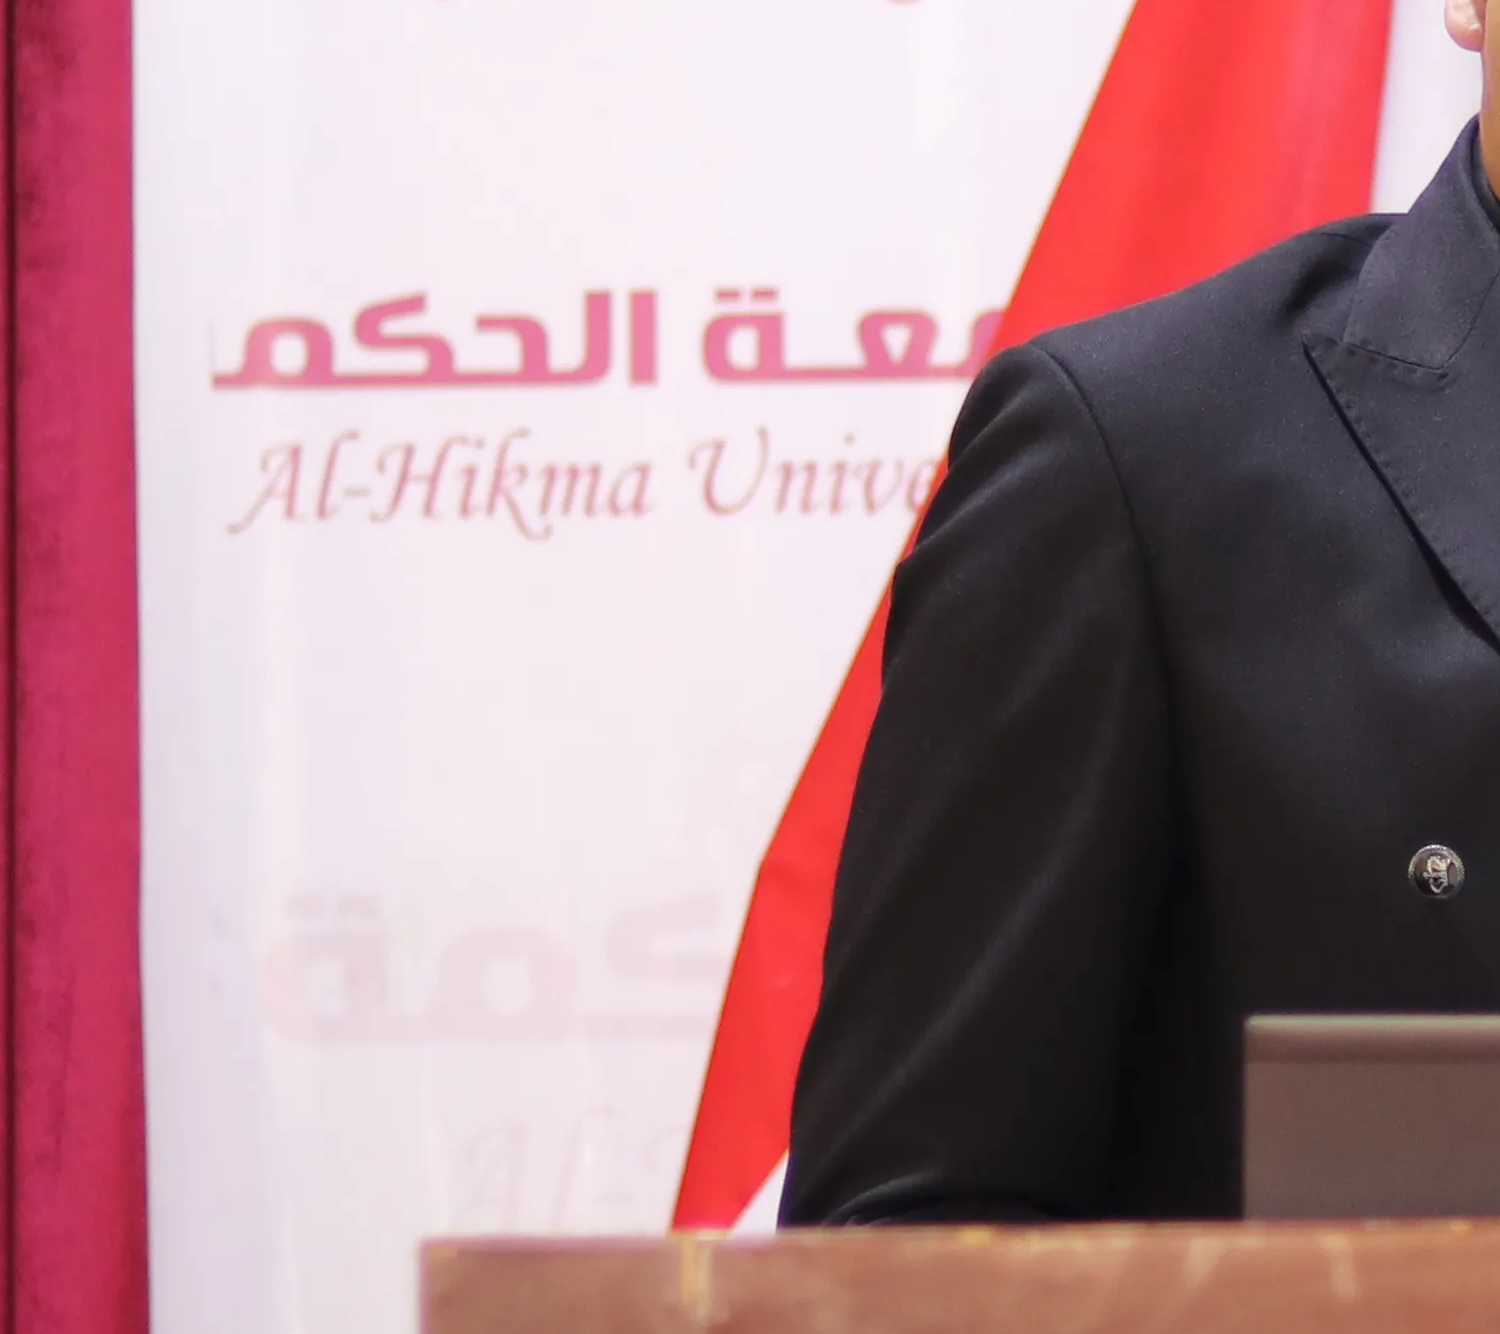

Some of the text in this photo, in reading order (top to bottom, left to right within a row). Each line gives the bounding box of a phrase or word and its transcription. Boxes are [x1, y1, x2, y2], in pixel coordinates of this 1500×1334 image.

[212, 288, 658, 391] الحكم
[226, 425, 941, 541] Al-Hikma Unive
